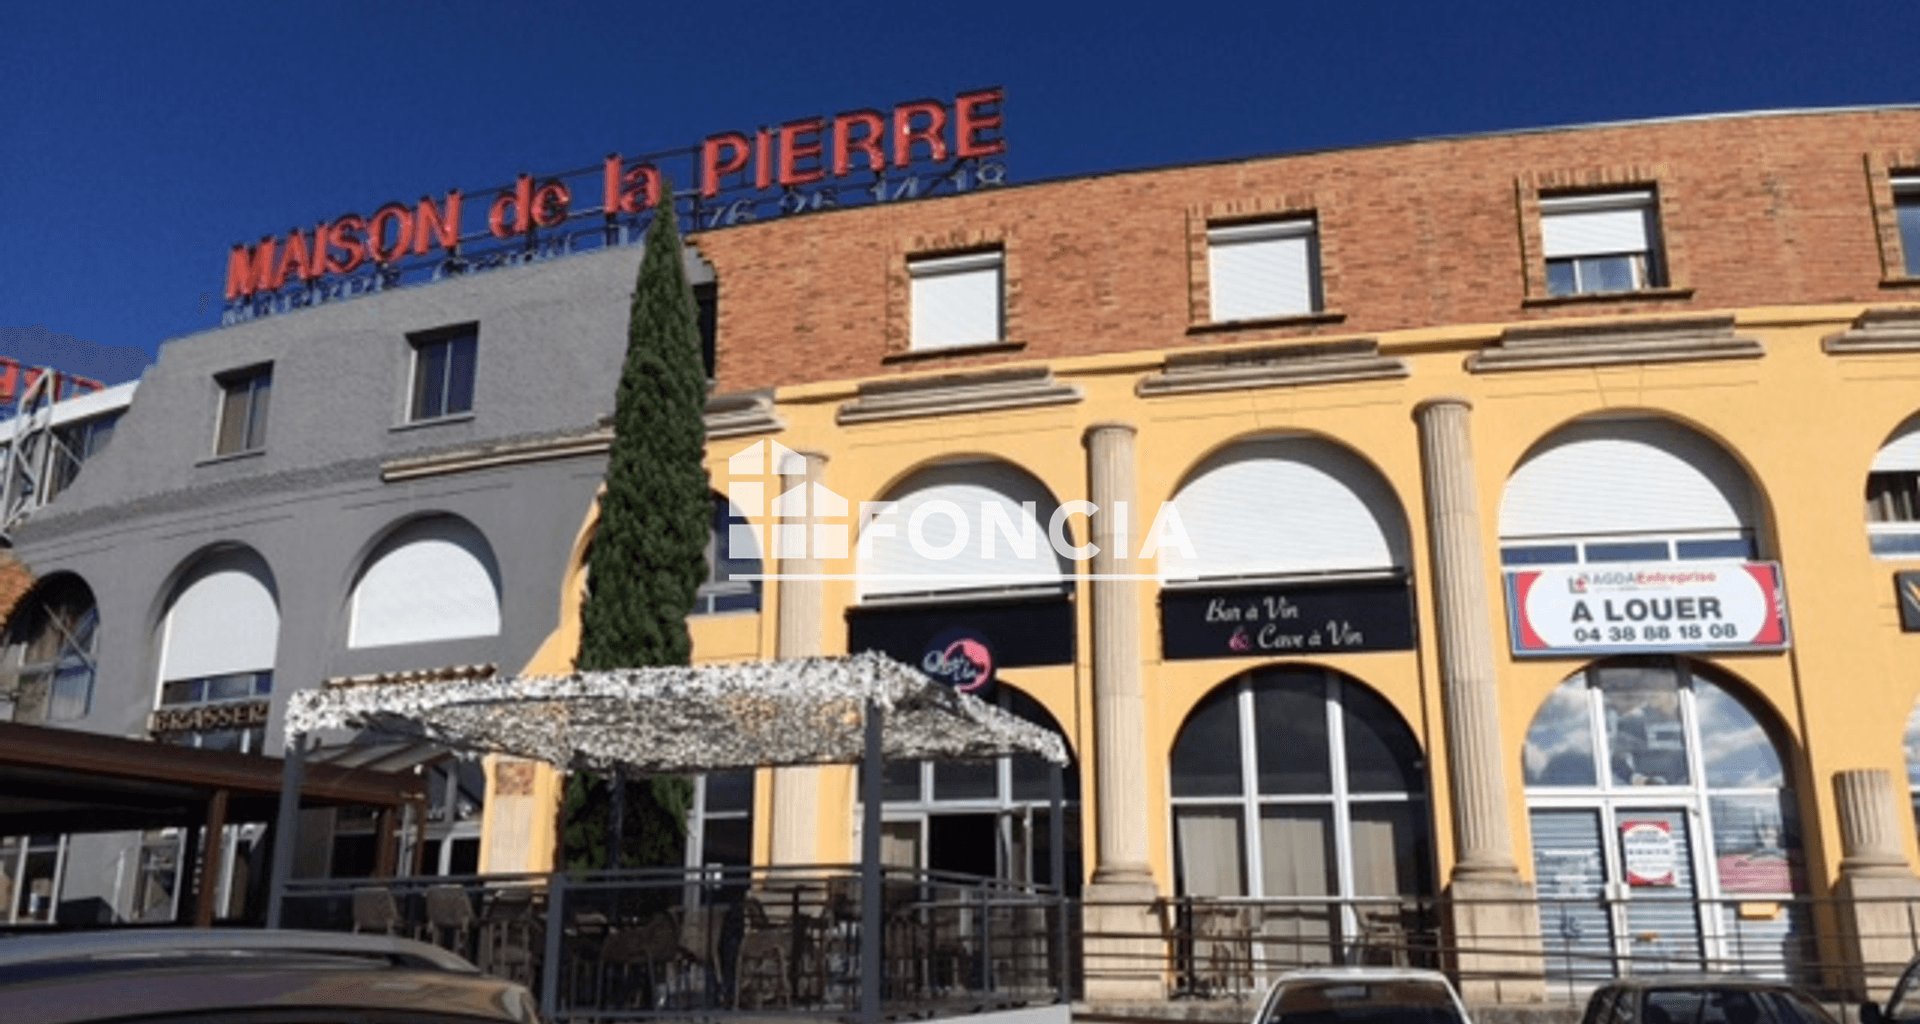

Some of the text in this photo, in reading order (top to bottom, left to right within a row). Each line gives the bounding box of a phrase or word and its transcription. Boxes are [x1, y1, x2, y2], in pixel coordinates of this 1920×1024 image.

[226, 189, 463, 300] MAISON
[488, 173, 572, 240] de
[604, 152, 661, 215] la
[701, 86, 1005, 199] PIERRE
[1206, 597, 1298, 623] Bar à Vin
[1571, 597, 1722, 623] A LOUER
[1257, 623, 1303, 649] Cave
[1308, 629, 1321, 647] à
[1327, 620, 1364, 647] Vin
[1574, 623, 1738, 642] 04 38 88 18 08
